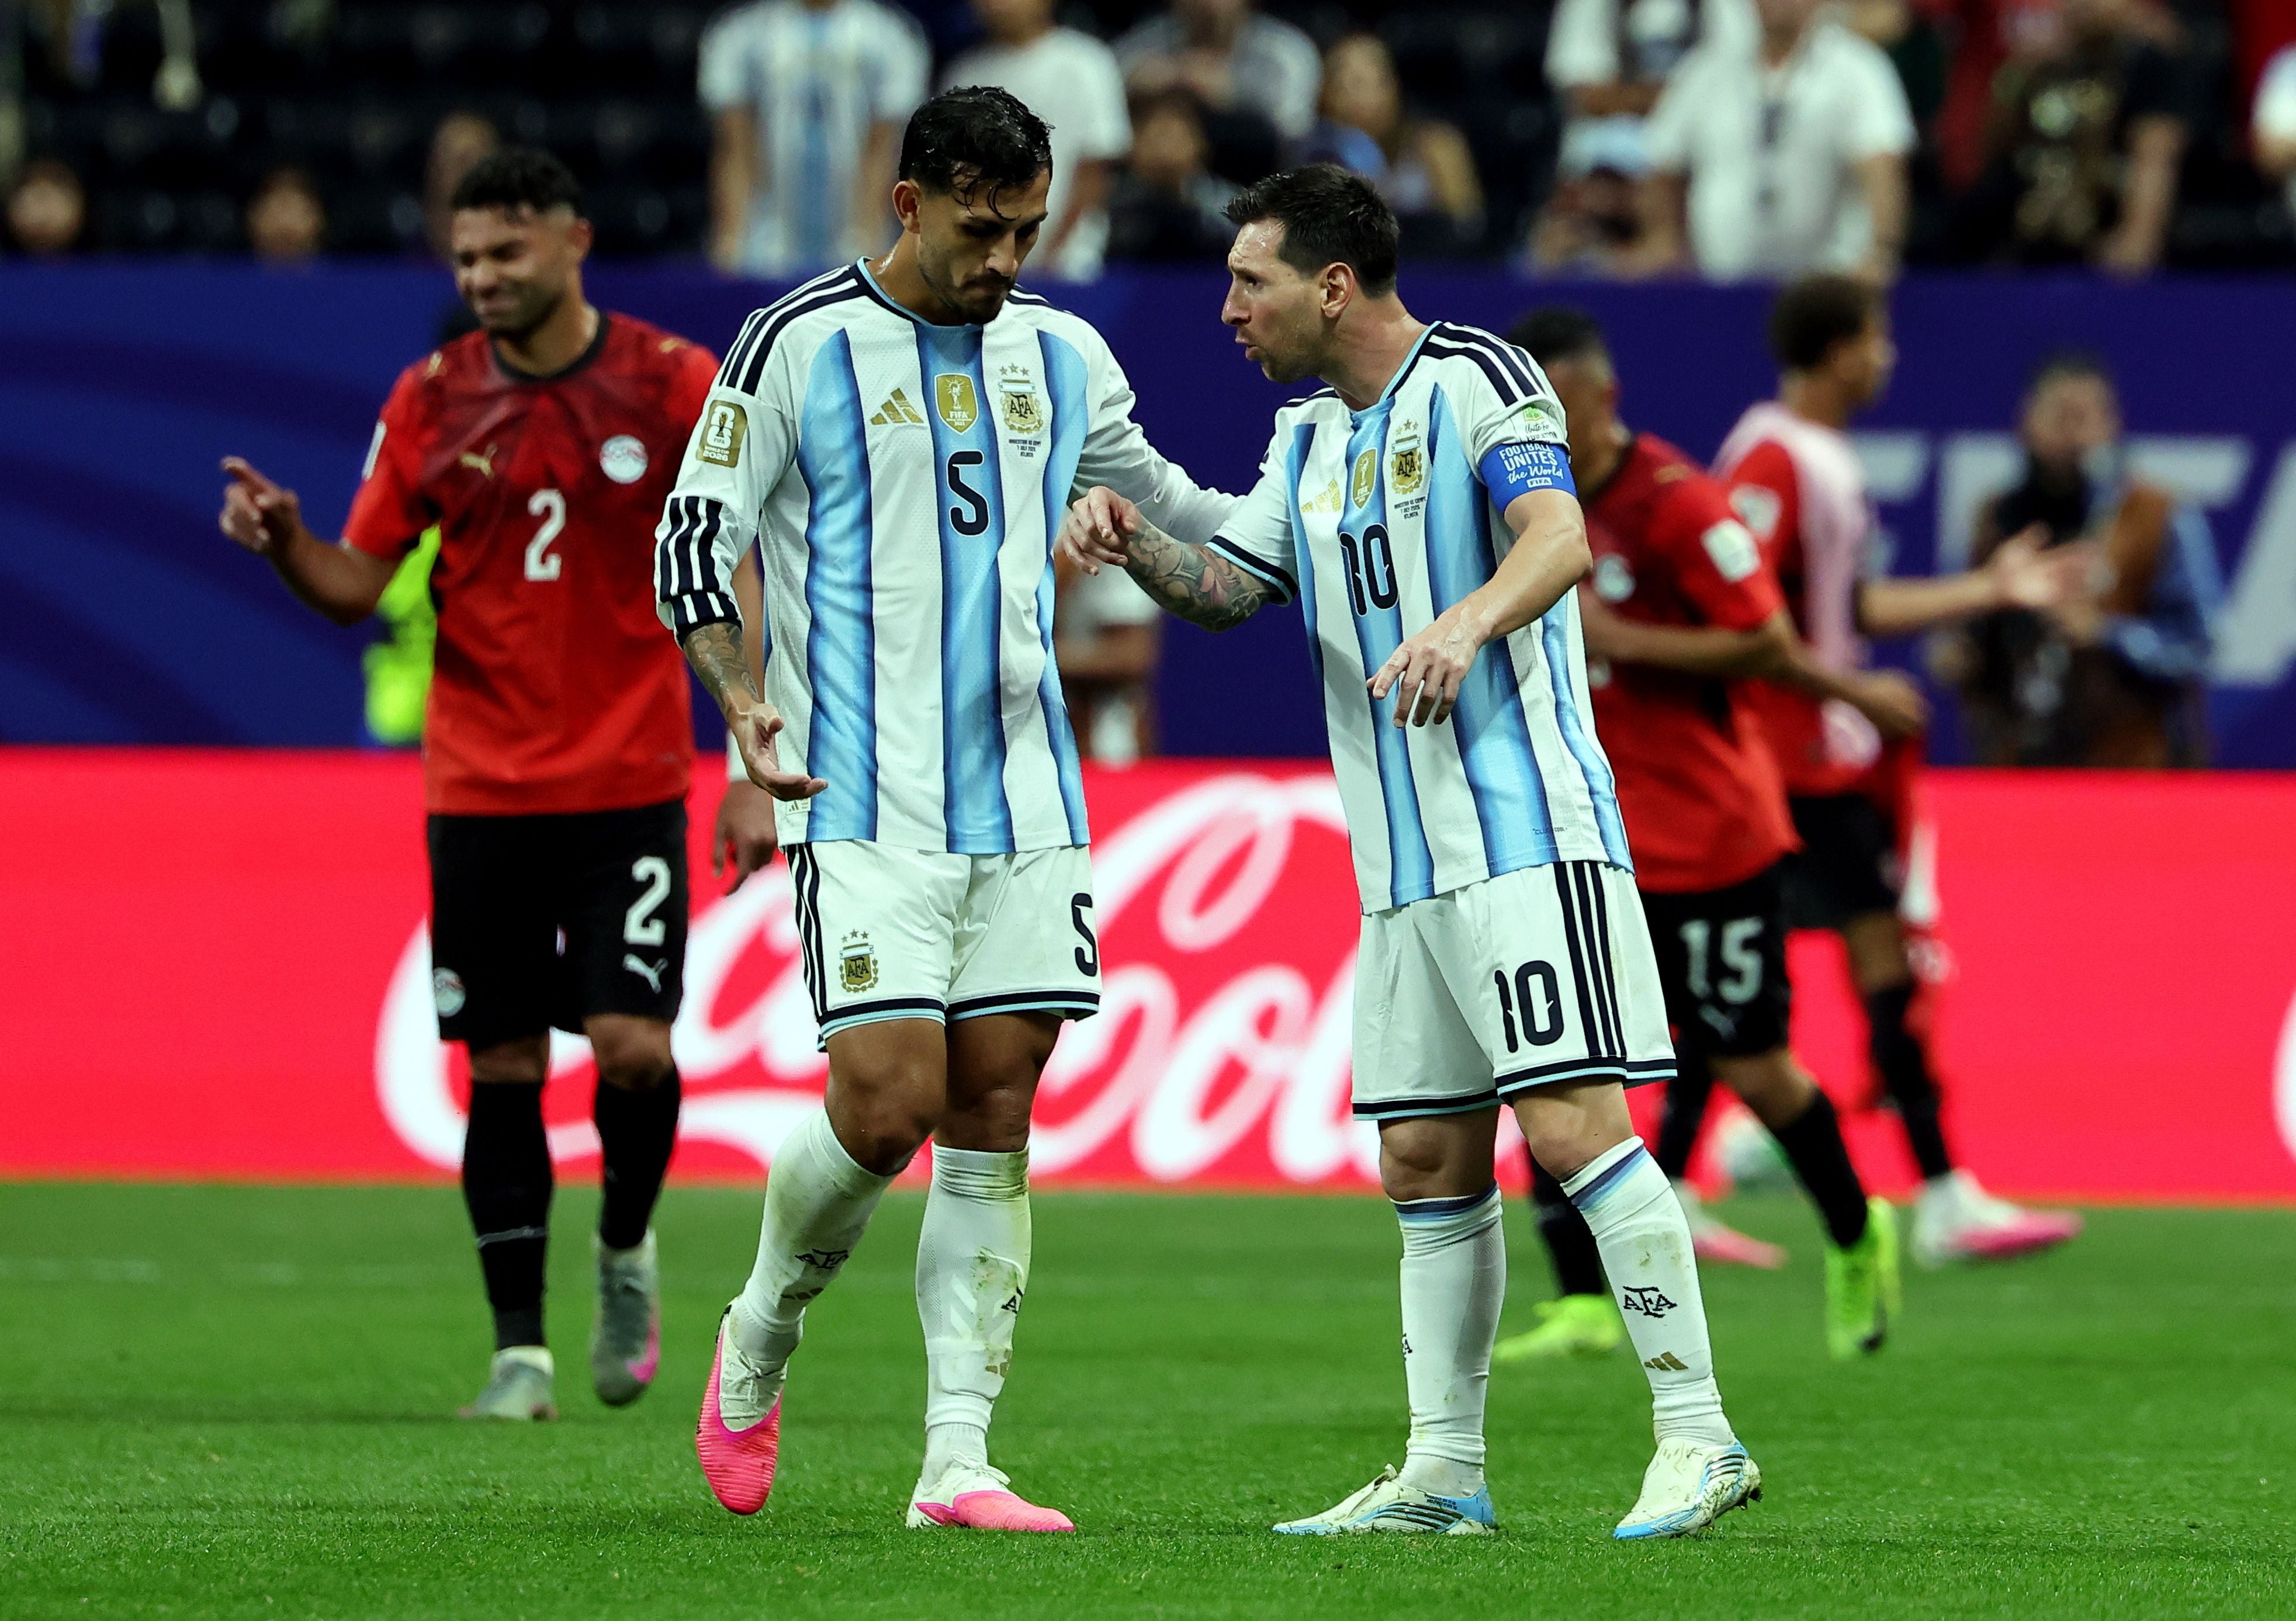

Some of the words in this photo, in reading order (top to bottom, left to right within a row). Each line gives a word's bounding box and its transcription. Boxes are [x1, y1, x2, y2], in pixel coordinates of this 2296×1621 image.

[702, 450, 729, 462] 2026
[947, 451, 989, 536] 5
[1499, 443, 1553, 460] FOOTBALL
[1504, 451, 1558, 472] UNITES
[1507, 470, 1528, 484] the
[1528, 466, 1564, 479] World
[524, 488, 566, 582] 2
[1339, 523, 1399, 616] 10
[624, 856, 671, 946] 2
[1071, 892, 1098, 977] 5
[847, 957, 870, 979] AFA
[1678, 916, 1765, 1005] 15
[1494, 960, 1564, 1053] 10
[1622, 1286, 1678, 1318] AFA
